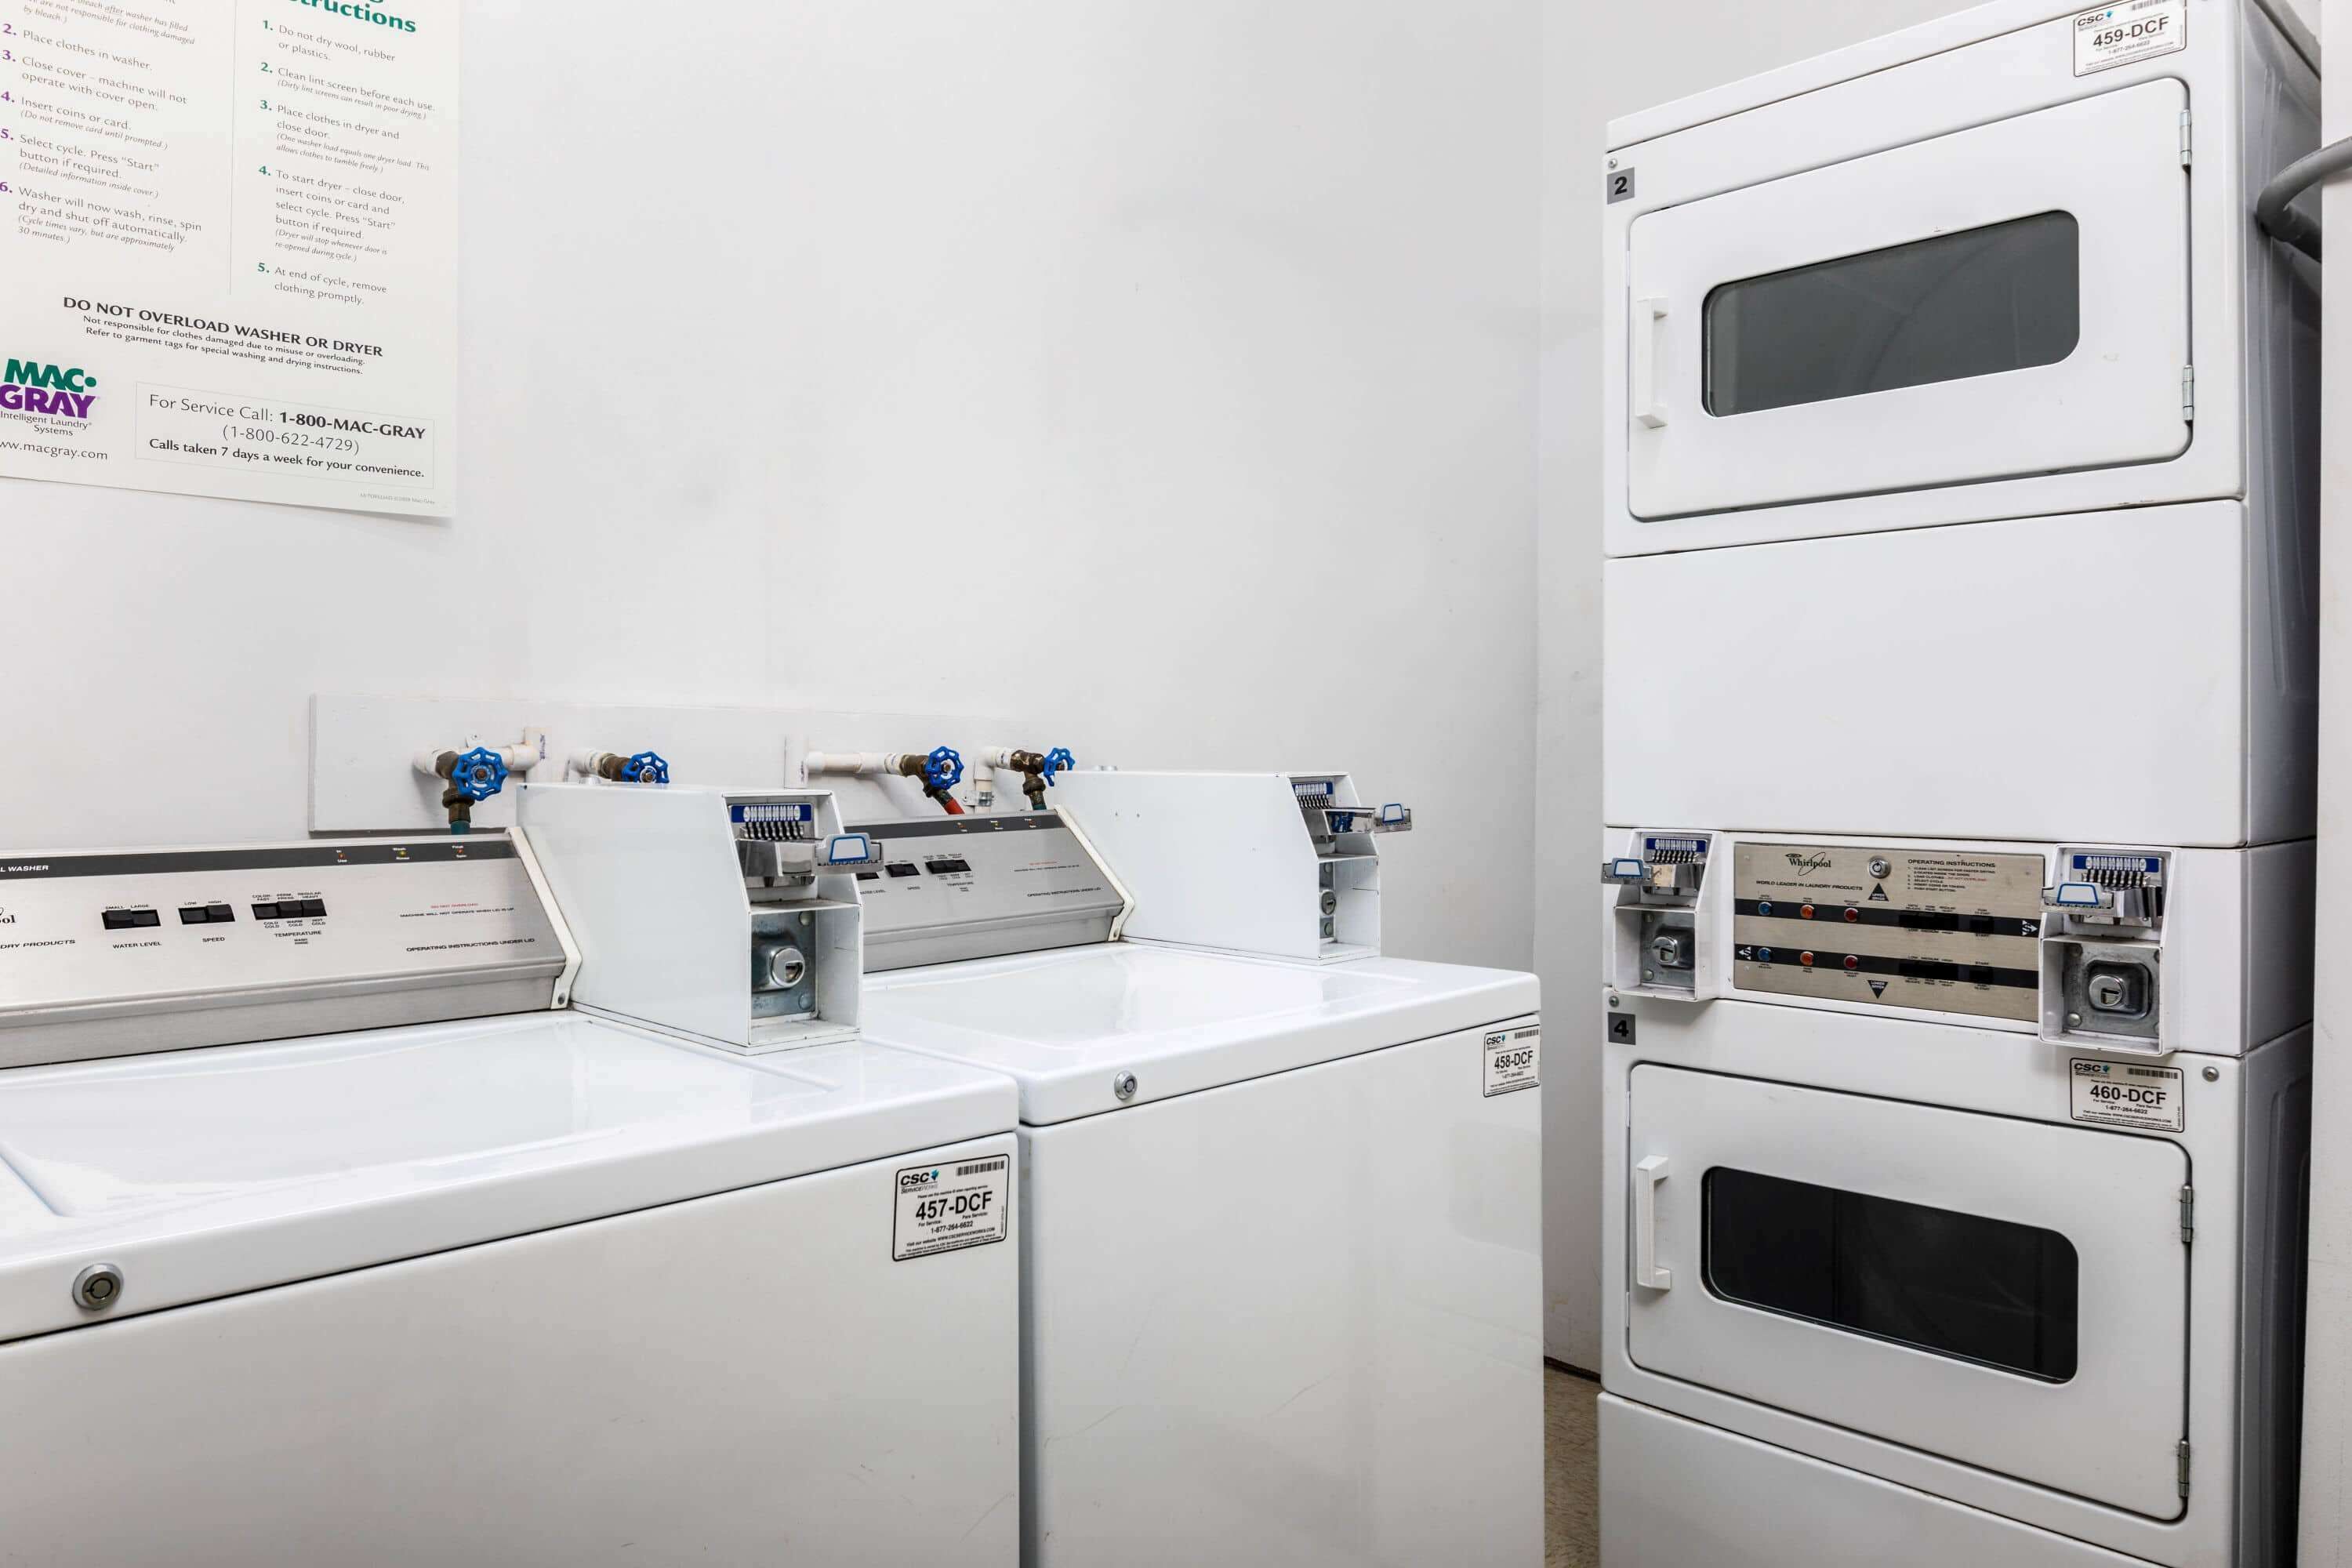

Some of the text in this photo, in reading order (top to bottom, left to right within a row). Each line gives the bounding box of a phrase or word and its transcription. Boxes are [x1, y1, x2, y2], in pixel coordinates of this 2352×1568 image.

[2078, 13, 2104, 26] CSC
[2093, 16, 2169, 46] 459-DCF
[2, 24, 151, 71] 2. Place clothes in washer.
[263, 20, 395, 61] 1. Do not dry wool, rubber
[292, 45, 330, 60] plastics.
[1, 49, 187, 103] 3. Close cover machine will not
[260, 62, 434, 111] 2. Clean lint screen before each use.
[22, 72, 157, 111] operate with cover open.
[0, 91, 131, 130] 4. Insert coins or card.
[260, 100, 272, 111] 3.
[278, 104, 303, 119] Place
[305, 112, 340, 126] clothes
[354, 122, 379, 135] dryer
[381, 130, 399, 140] and
[277, 121, 329, 139] close door.
[0, 128, 13, 141] 5.
[19, 133, 53, 150] Select
[56, 144, 86, 157] cycle.
[90, 150, 118, 163] Press
[20, 149, 122, 179] button if required.
[1614, 176, 1628, 194] 2
[18, 186, 62, 203] Washer
[64, 198, 83, 207] will
[87, 202, 111, 214] now
[112, 208, 145, 221] wash,
[148, 213, 176, 228] rinse,
[180, 221, 201, 231] spin
[19, 201, 187, 244] dry and shut off automatically.
[257, 262, 387, 292] 5. At end of cycle, remove
[274, 281, 364, 306] clothing promptly.
[64, 296, 383, 357] DO NOT OVERLOAD WASHER OR DRYER
[83, 315, 101, 325] Not
[103, 320, 154, 332] responsible
[157, 326, 170, 336] for
[172, 328, 202, 340] clothes
[205, 334, 245, 347] damaged
[245, 340, 262, 350] due
[275, 345, 303, 355] misuse
[317, 353, 365, 366] overloading.
[86, 326, 110, 336] Refer
[125, 335, 162, 345] garment
[165, 340, 183, 350] tags
[186, 342, 198, 350] for
[201, 347, 229, 355] special
[231, 350, 266, 362] washing
[285, 358, 312, 369] drying
[314, 361, 362, 374] instructions.
[1, 411, 46, 423] Intelligent
[34, 424, 74, 437] Systems
[151, 394, 425, 439] For Service Call: 1-800-MAC-GRAY
[223, 424, 358, 456] (1-800-622-4729)
[149, 438, 179, 451] Calls
[183, 443, 216, 455] taken
[221, 446, 228, 456] 7
[232, 448, 259, 463] days
[273, 454, 303, 464] week
[306, 456, 324, 466] for
[326, 461, 352, 470] your
[355, 464, 423, 477] convenience.
[1788, 858, 1831, 869] Whirlpool
[1486, 1036, 1501, 1045] CSC
[1613, 1019, 1629, 1037] 4
[1494, 1050, 1534, 1069] 458-DCF
[2074, 1063, 2101, 1073] CSC
[2090, 1084, 2166, 1105] 460-DCF
[900, 1172, 930, 1186] CSC
[916, 1191, 993, 1221] 457-DCF
